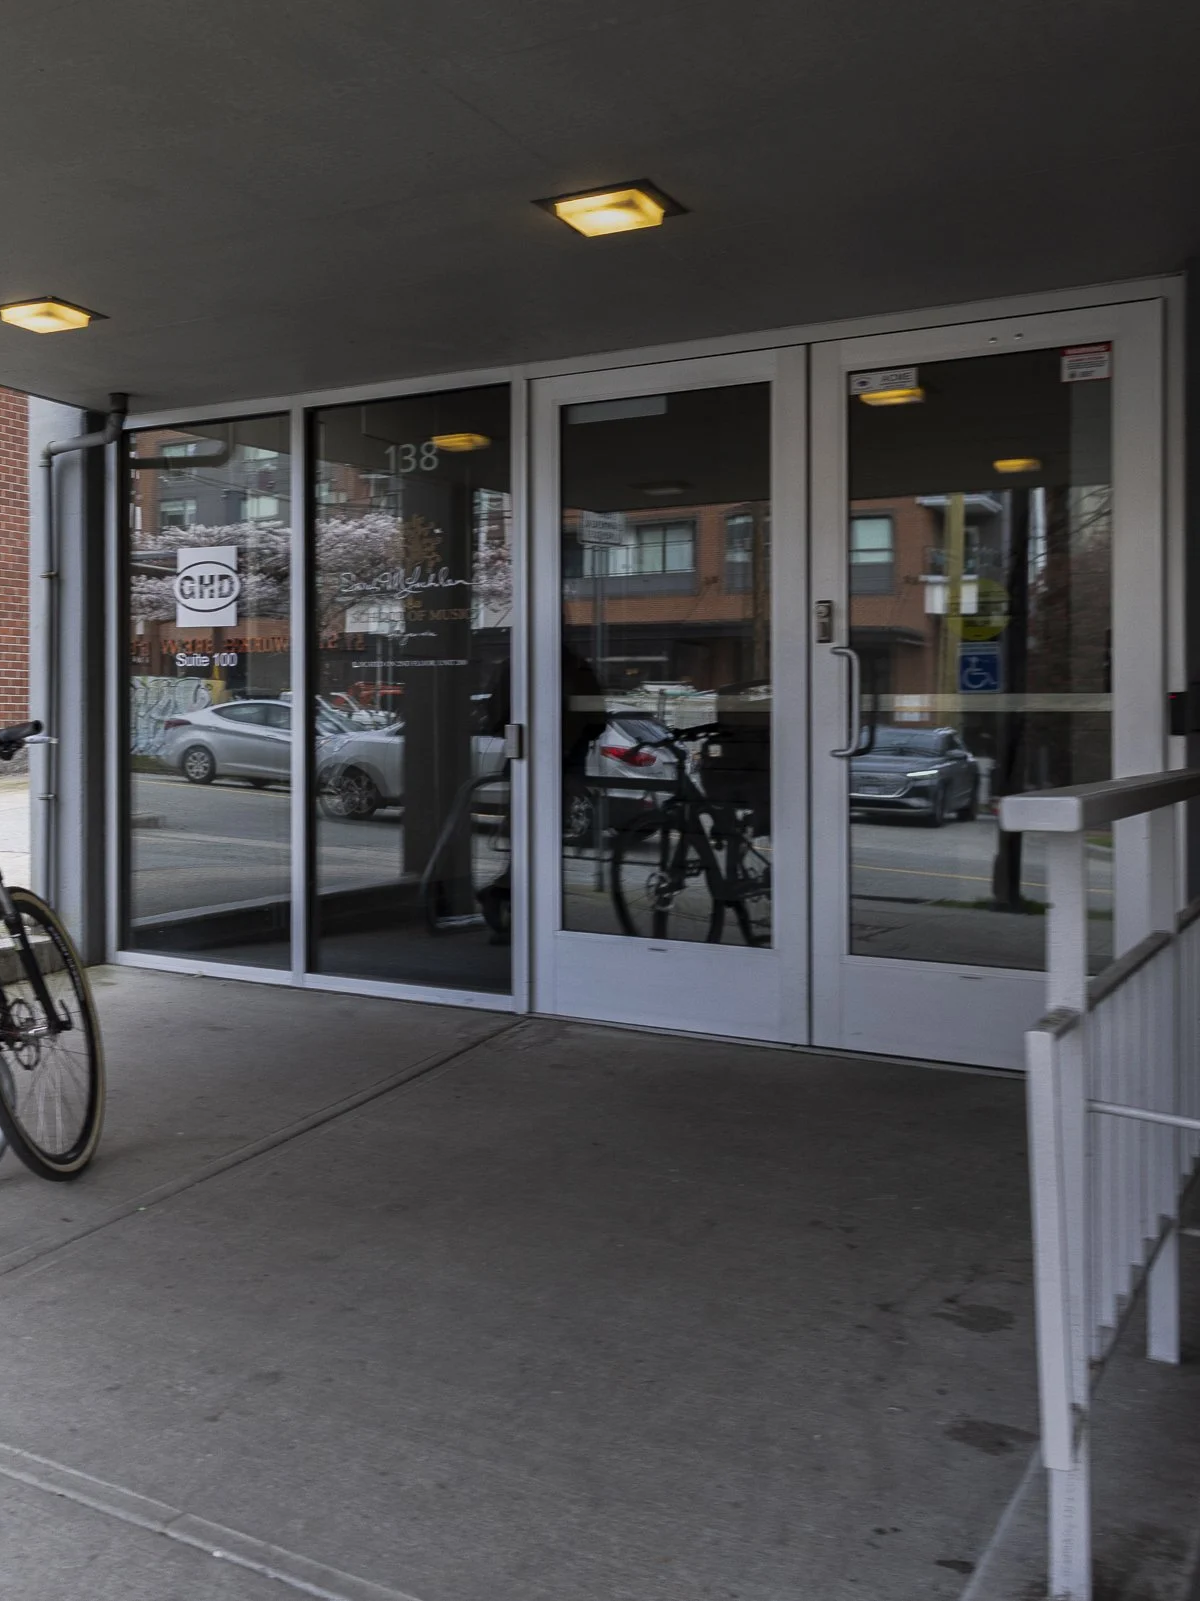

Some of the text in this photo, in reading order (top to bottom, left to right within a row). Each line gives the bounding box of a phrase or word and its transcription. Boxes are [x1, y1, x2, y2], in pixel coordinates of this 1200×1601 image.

[384, 442, 439, 473] 138
[179, 574, 235, 600] GHD
[176, 653, 238, 667] Suite 100
